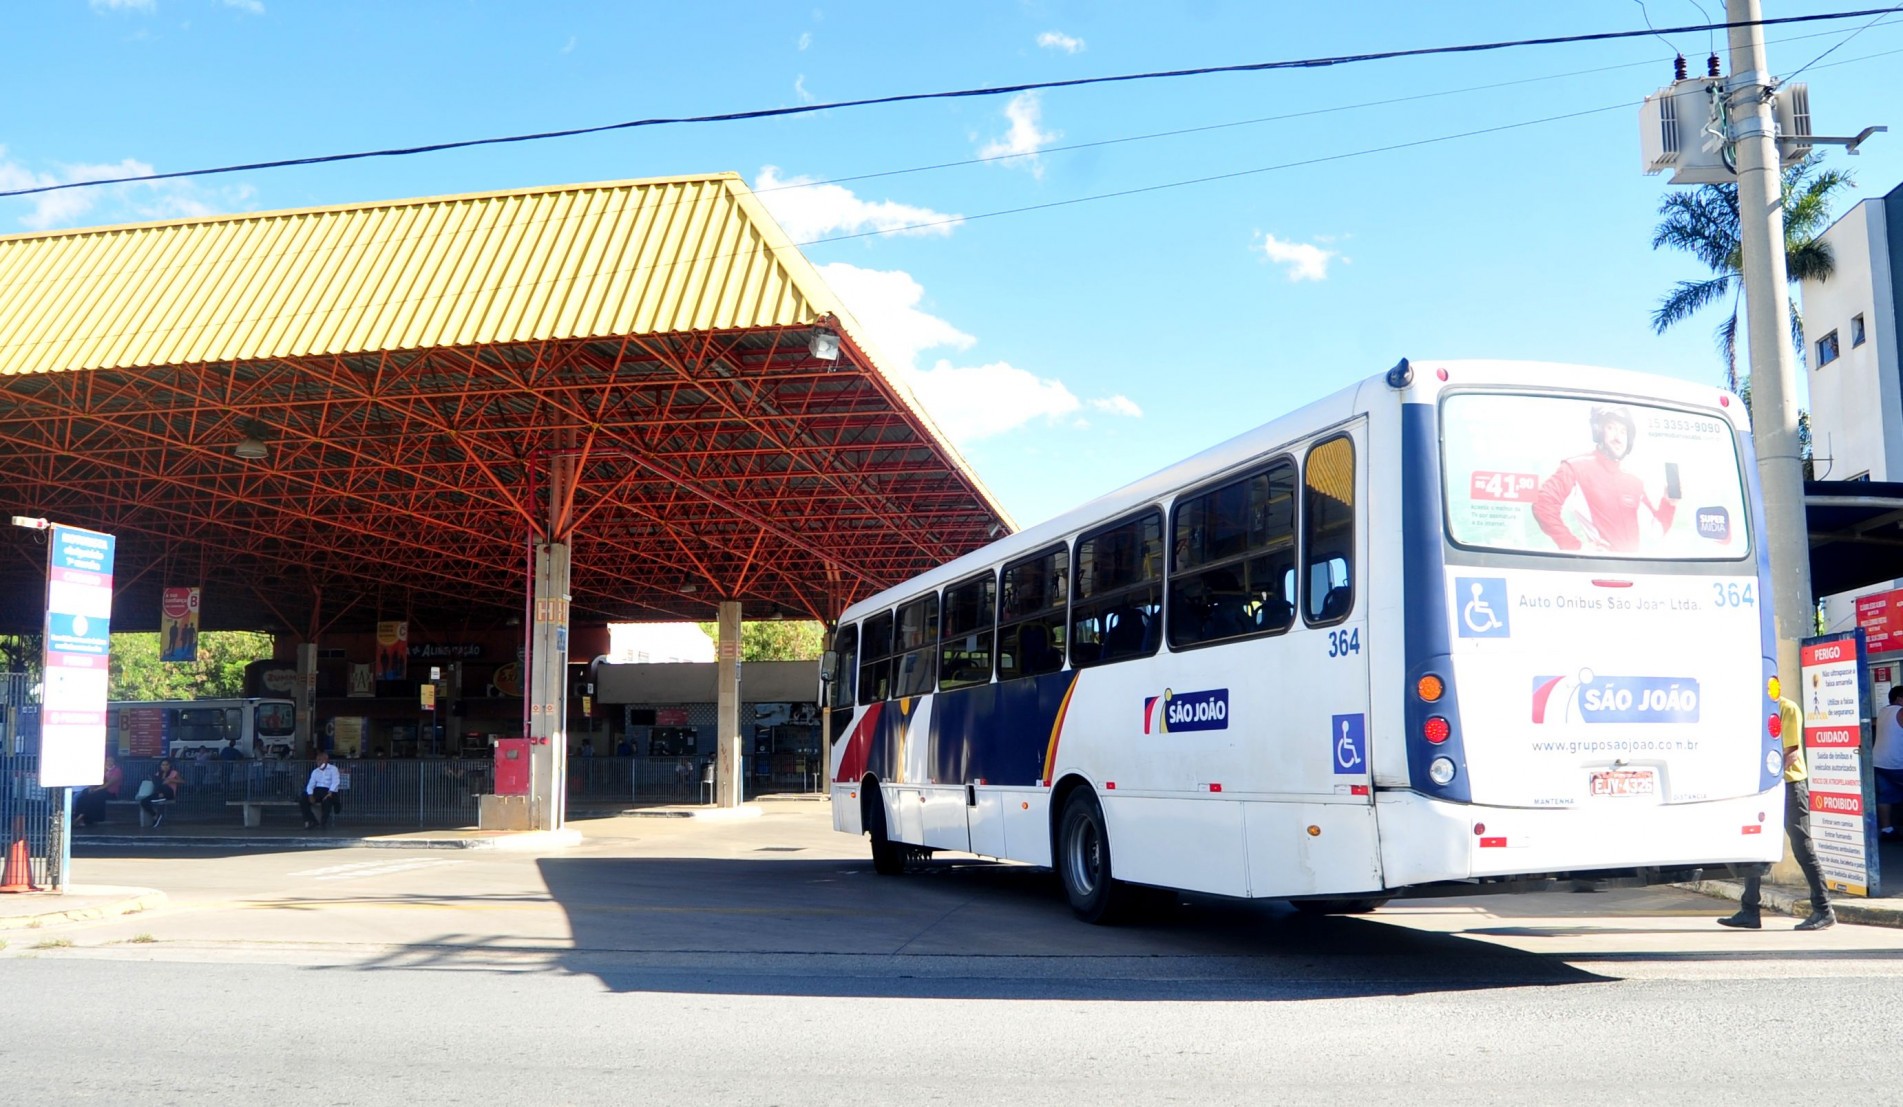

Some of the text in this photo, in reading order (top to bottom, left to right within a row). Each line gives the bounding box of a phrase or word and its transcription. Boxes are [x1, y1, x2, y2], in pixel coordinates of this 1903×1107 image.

[1664, 419, 1721, 433] 3353-9090
[1699, 514, 1725, 524] SUPER
[190, 595, 198, 608] B
[1712, 582, 1755, 608] 364
[1519, 594, 1551, 608] Auto
[1670, 597, 1702, 611] Ltda.
[536, 601, 555, 621] H
[1328, 627, 1360, 658] 364
[1814, 646, 1841, 661] PERIGO
[1831, 669, 1852, 678] ultrapasse
[1835, 679, 1853, 687] amarela
[1583, 683, 1697, 712] SÃO JOÃO
[1169, 696, 1226, 724] SÃO JOÃO
[1834, 709, 1855, 718] segurança
[1816, 730, 1849, 743] CUIDADO
[1829, 752, 1834, 760] de
[1832, 764, 1857, 772] autorizados
[1824, 796, 1859, 811] PROIBIDO
[1841, 820, 1854, 828] camisa
[1825, 830, 1853, 840] Entrar fumando
[1818, 842, 1861, 855] Vendedores ambulantes
